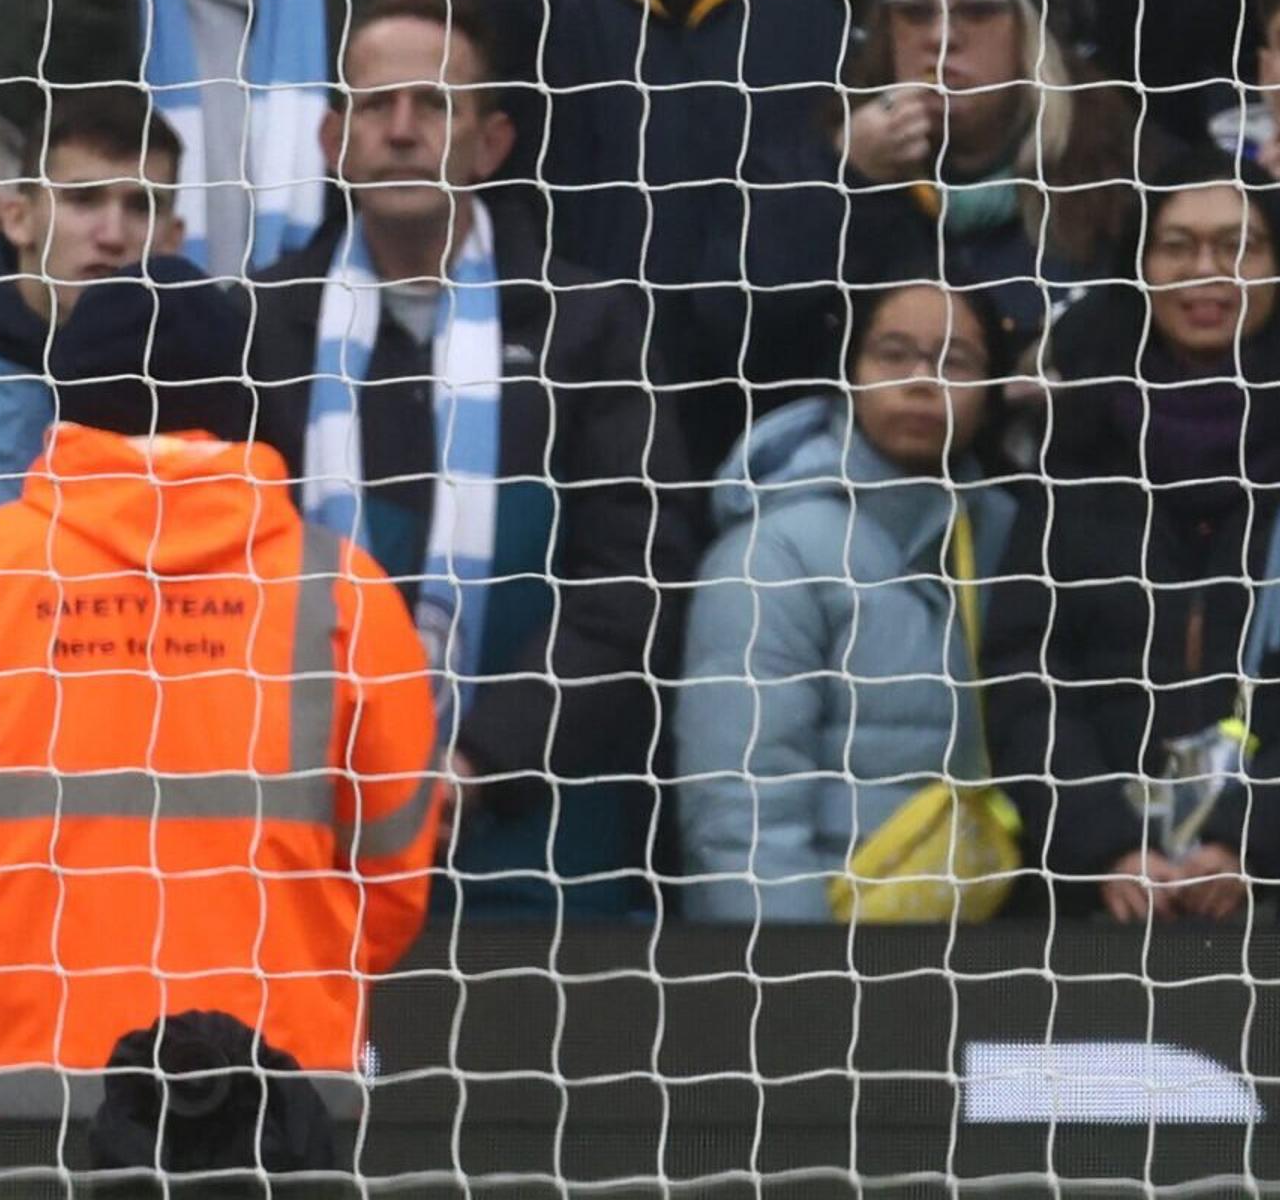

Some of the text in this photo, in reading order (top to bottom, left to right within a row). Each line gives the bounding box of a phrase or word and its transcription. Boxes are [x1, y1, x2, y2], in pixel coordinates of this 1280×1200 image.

[37, 594, 245, 620] SAFETY TEAM
[53, 636, 226, 661] here to help
